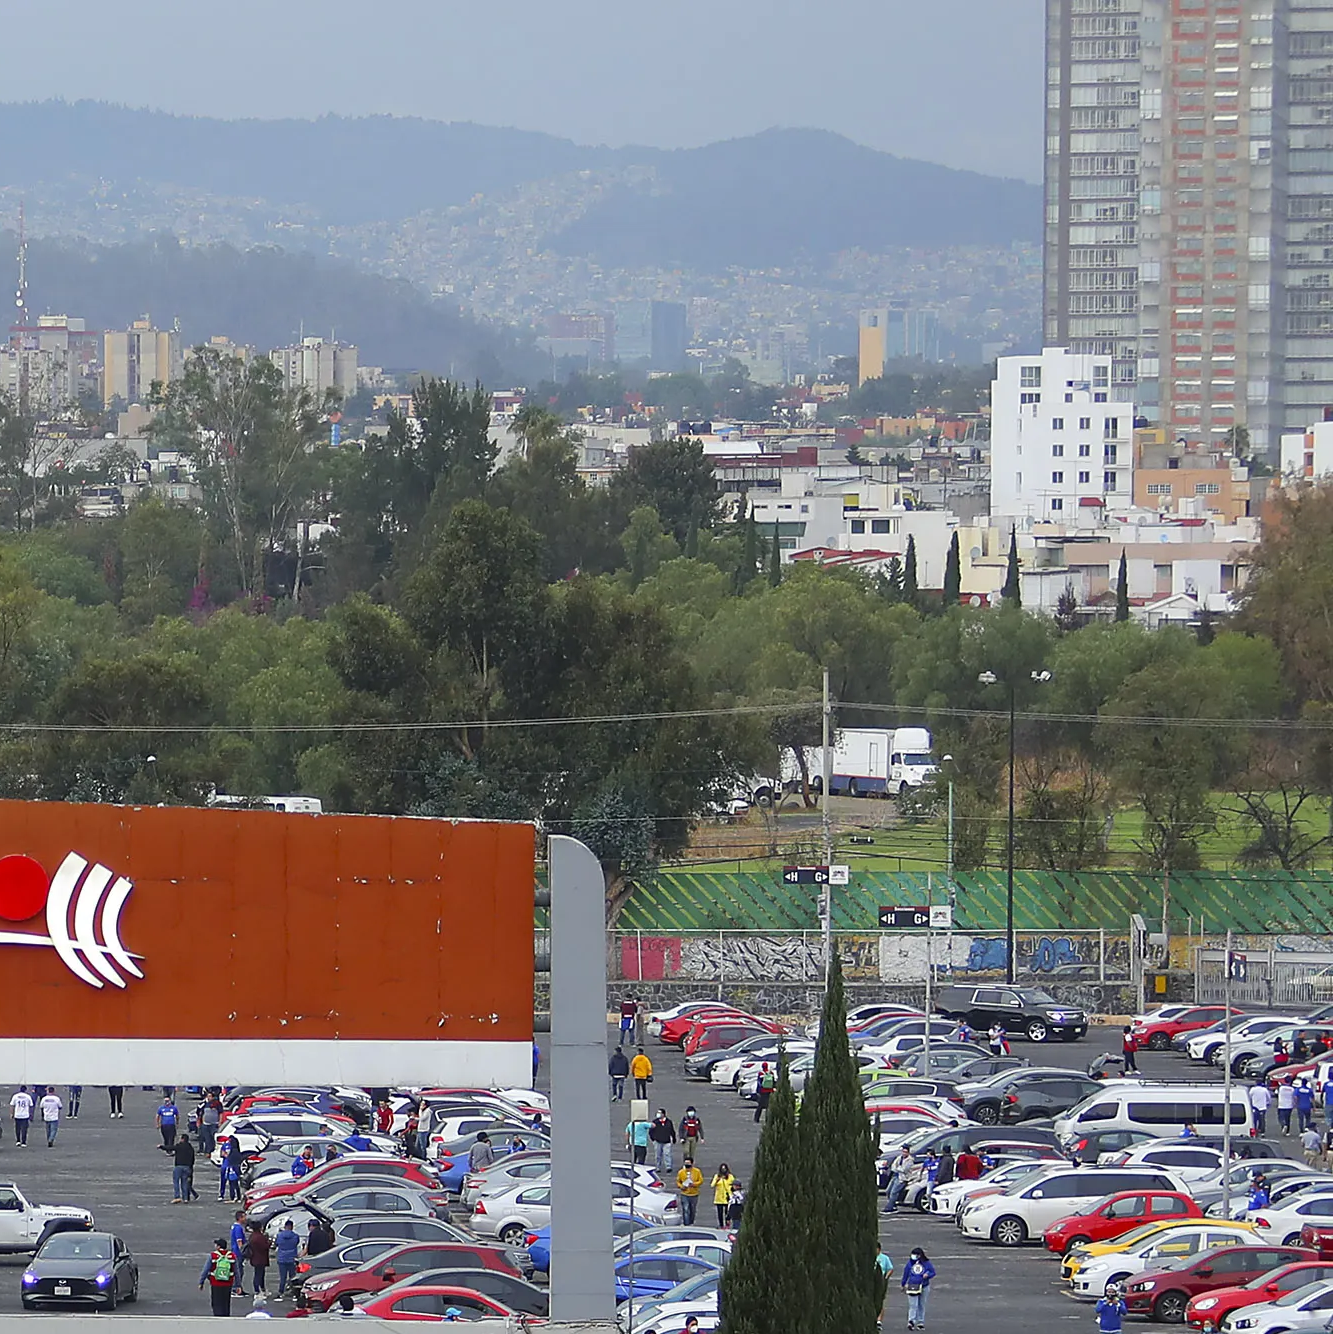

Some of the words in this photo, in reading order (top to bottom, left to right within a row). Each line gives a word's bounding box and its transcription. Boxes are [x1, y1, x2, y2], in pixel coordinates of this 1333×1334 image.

[791, 871, 798, 882] H
[815, 871, 822, 882] G
[888, 913, 895, 924] H
[914, 913, 922, 924] G
[18, 1100, 26, 1108] 18
